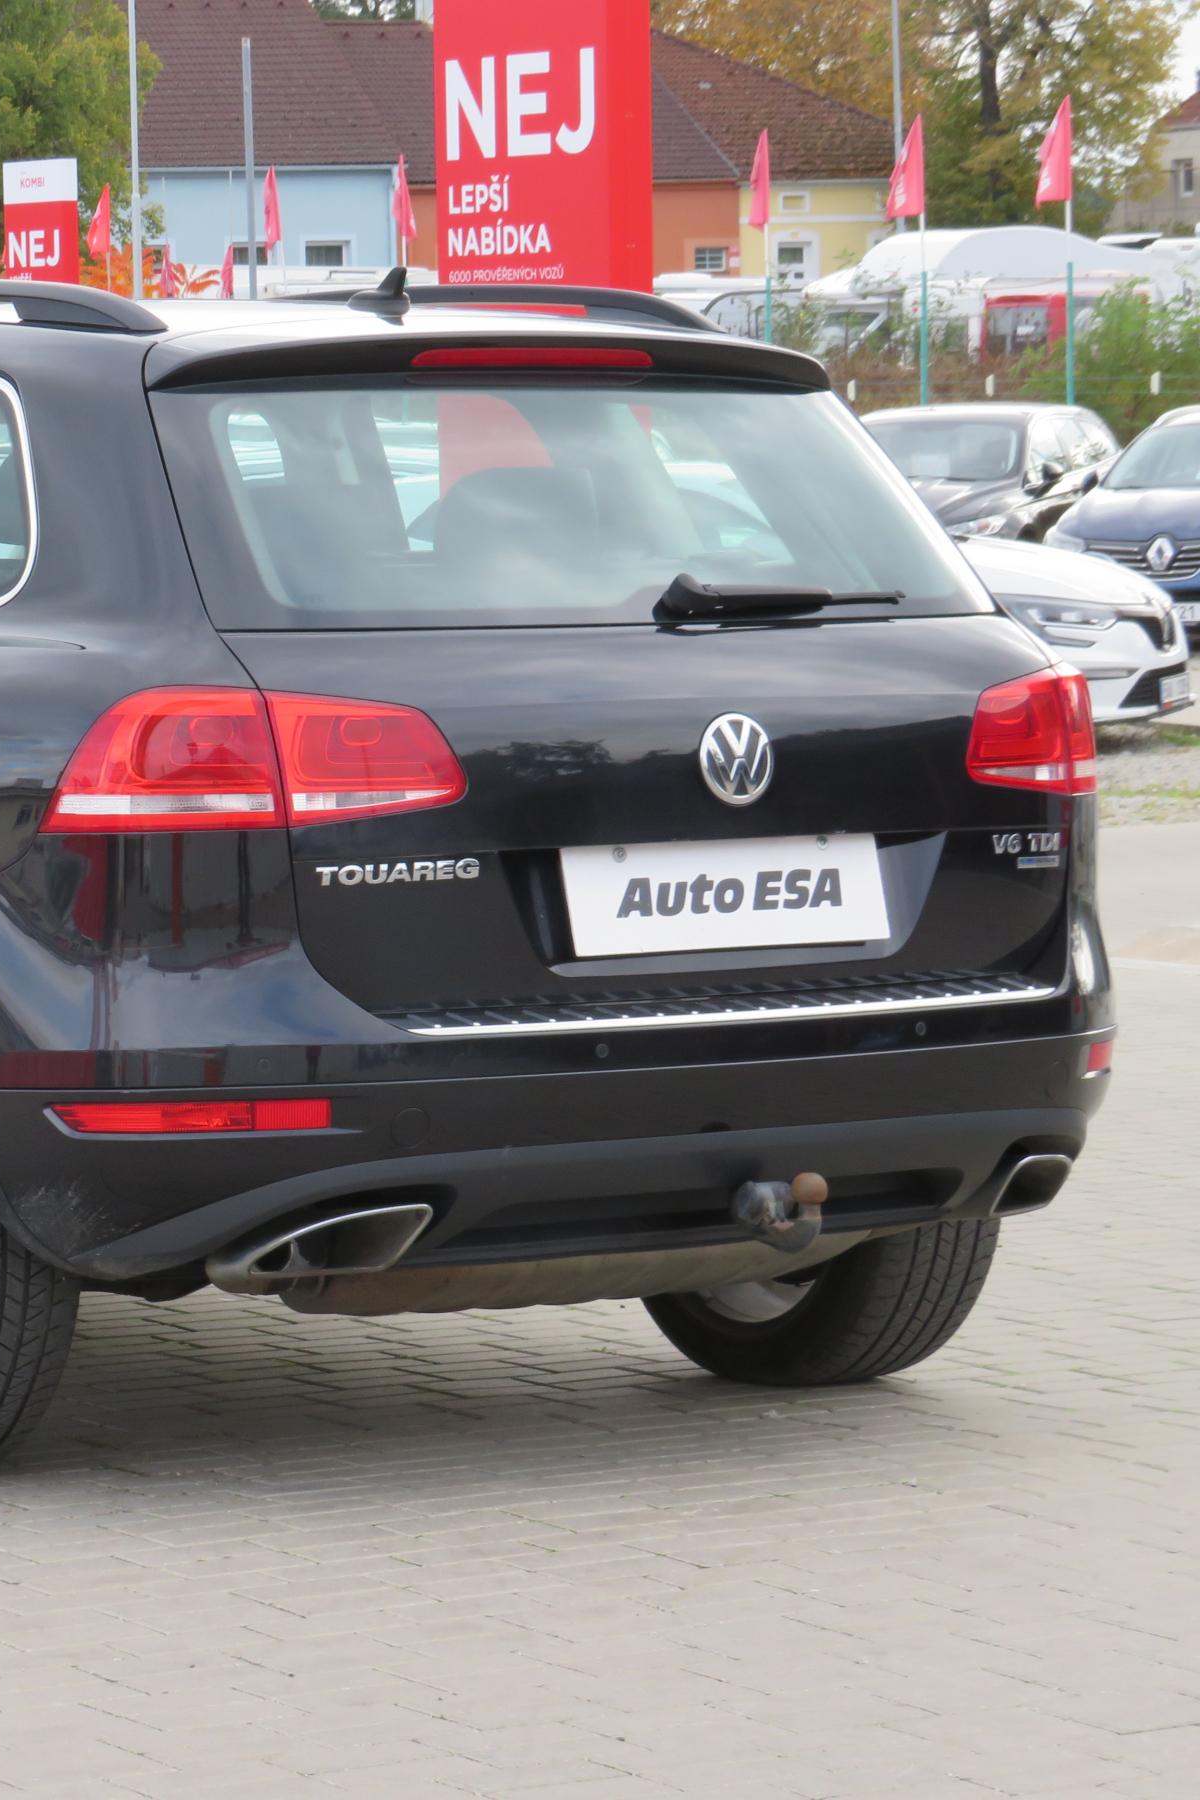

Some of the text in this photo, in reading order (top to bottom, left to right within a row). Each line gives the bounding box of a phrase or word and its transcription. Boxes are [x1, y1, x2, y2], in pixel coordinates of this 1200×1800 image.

[445, 47, 595, 161] NEJ
[20, 177, 45, 189] KOMBI
[448, 174, 509, 215] LEPŠÍ
[8, 229, 60, 268] NEJ
[448, 218, 551, 257] NABÍDKA
[448, 270, 472, 283] 6000
[992, 832, 1060, 854] V6 TDI
[315, 857, 480, 887] TOUAREG
[616, 868, 842, 918] Auto ESA
